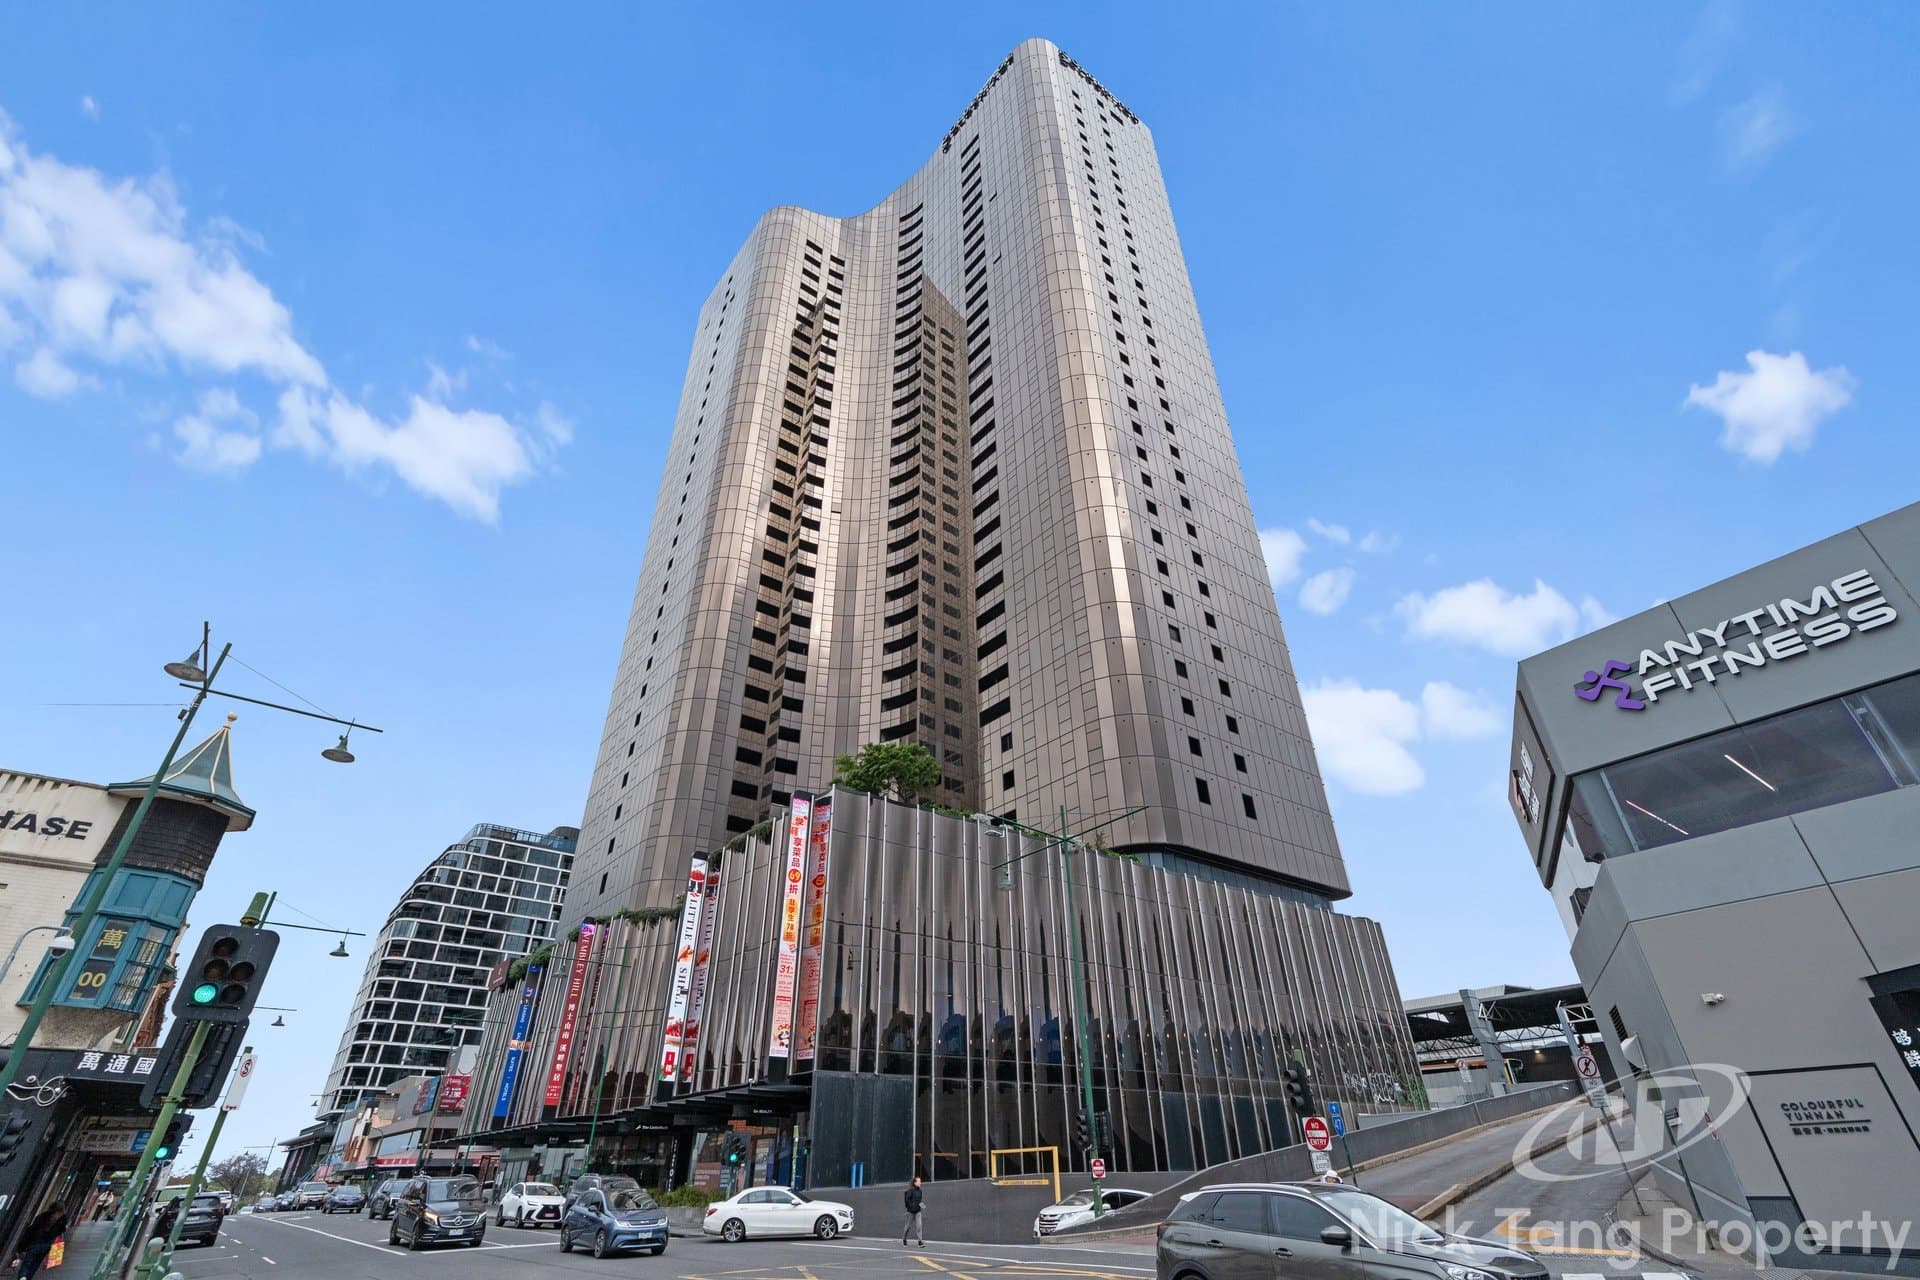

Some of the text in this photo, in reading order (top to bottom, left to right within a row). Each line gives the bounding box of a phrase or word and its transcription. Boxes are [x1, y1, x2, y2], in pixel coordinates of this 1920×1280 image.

[1638, 569, 1881, 676] ANYTIME
[1641, 596, 1897, 703] FITNESS
[97, 929, 128, 949] 萬
[570, 978, 582, 998] HILL
[77, 1052, 157, 1075] 萬通國
[1781, 1099, 1864, 1111] COLOURFUL
[1784, 1110, 1845, 1121] YUNNAN
[1310, 1138, 1327, 1146] ENTRY
